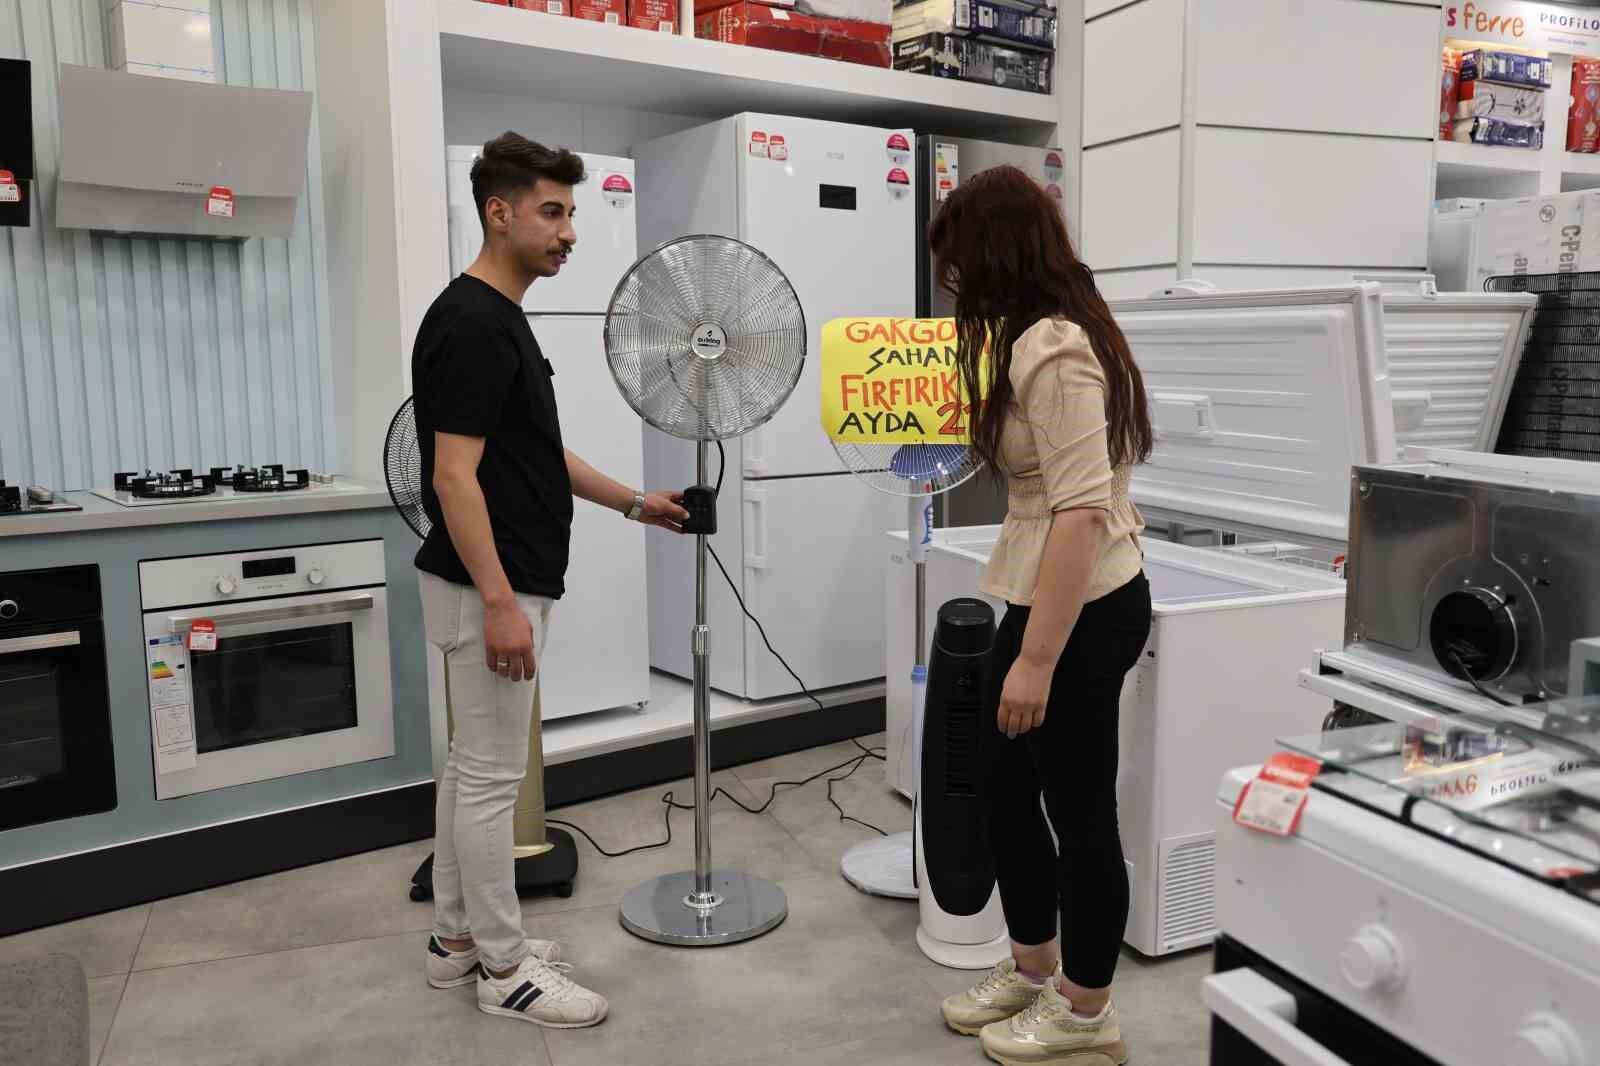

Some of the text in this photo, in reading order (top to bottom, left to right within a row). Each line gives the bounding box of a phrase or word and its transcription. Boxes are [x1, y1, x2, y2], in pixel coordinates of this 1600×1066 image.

[1463, 2, 1524, 37] ferre
[845, 319, 957, 345] GAKGO
[866, 346, 957, 375] SAHAN
[838, 401, 974, 435] AYDA 2
